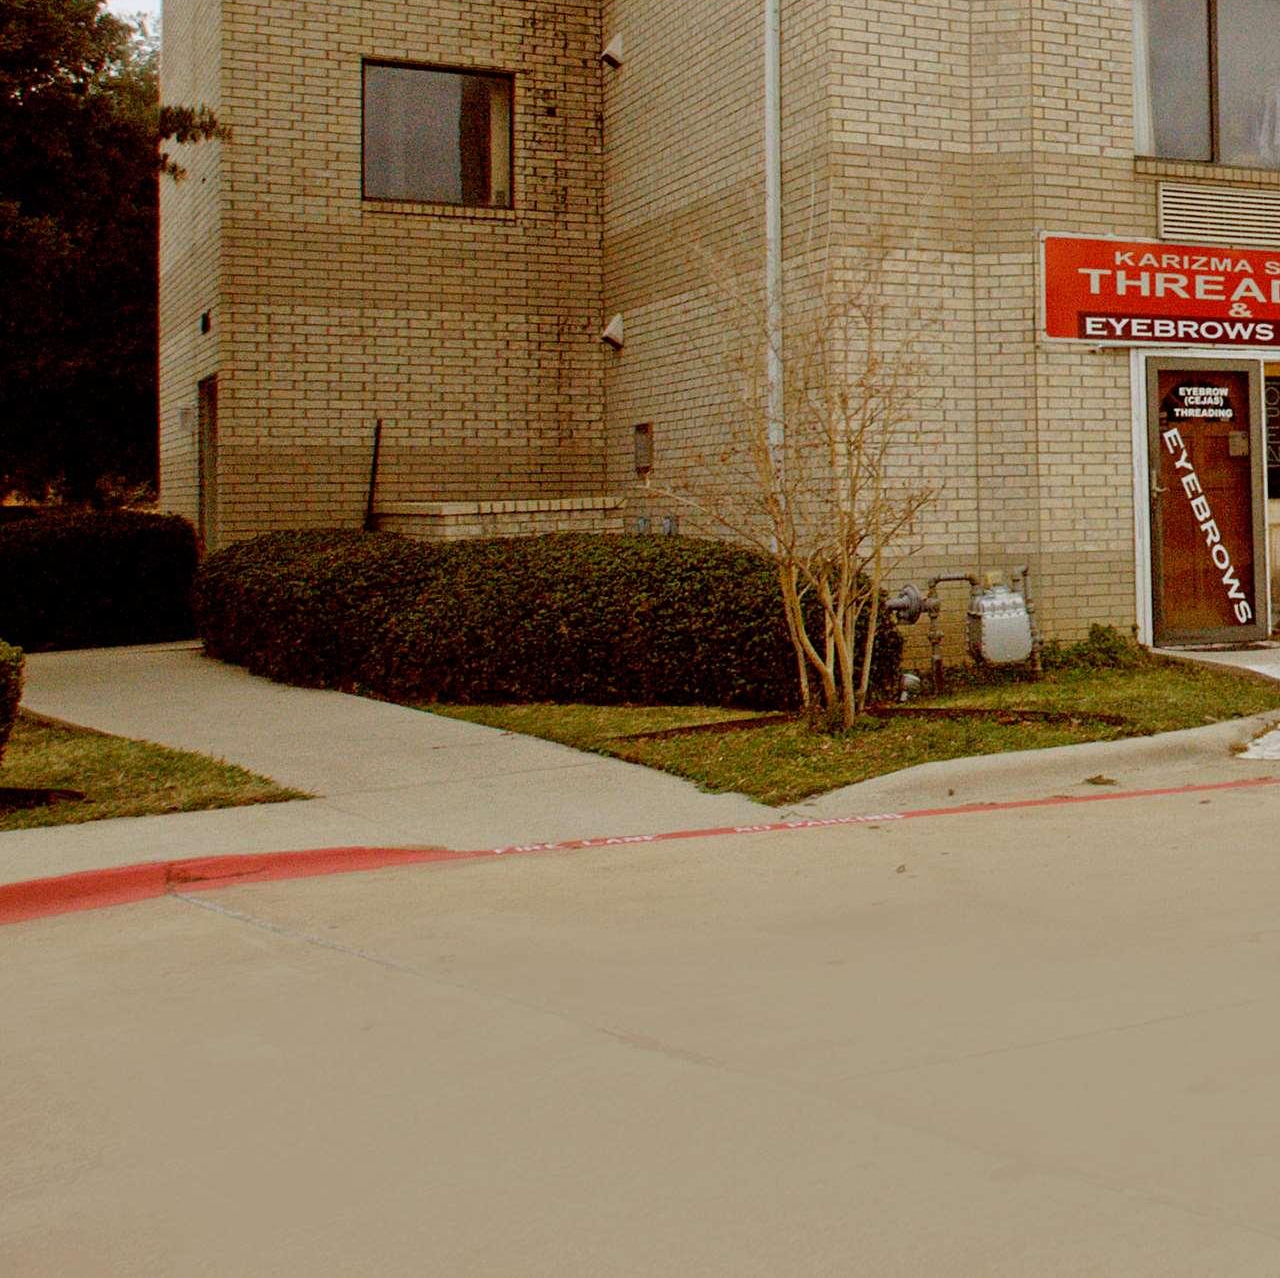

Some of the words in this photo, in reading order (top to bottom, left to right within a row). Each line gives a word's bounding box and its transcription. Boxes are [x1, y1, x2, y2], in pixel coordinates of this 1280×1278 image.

[1115, 251, 1253, 273] KARIZMA
[1228, 302, 1252, 318] &
[1085, 317, 1274, 341] EYEBROWS
[1178, 387, 1229, 397] EYEBROW
[1184, 396, 1224, 407] (CEJAS)
[1173, 407, 1233, 418] THREADING
[1162, 427, 1252, 624] EYEBROWS
